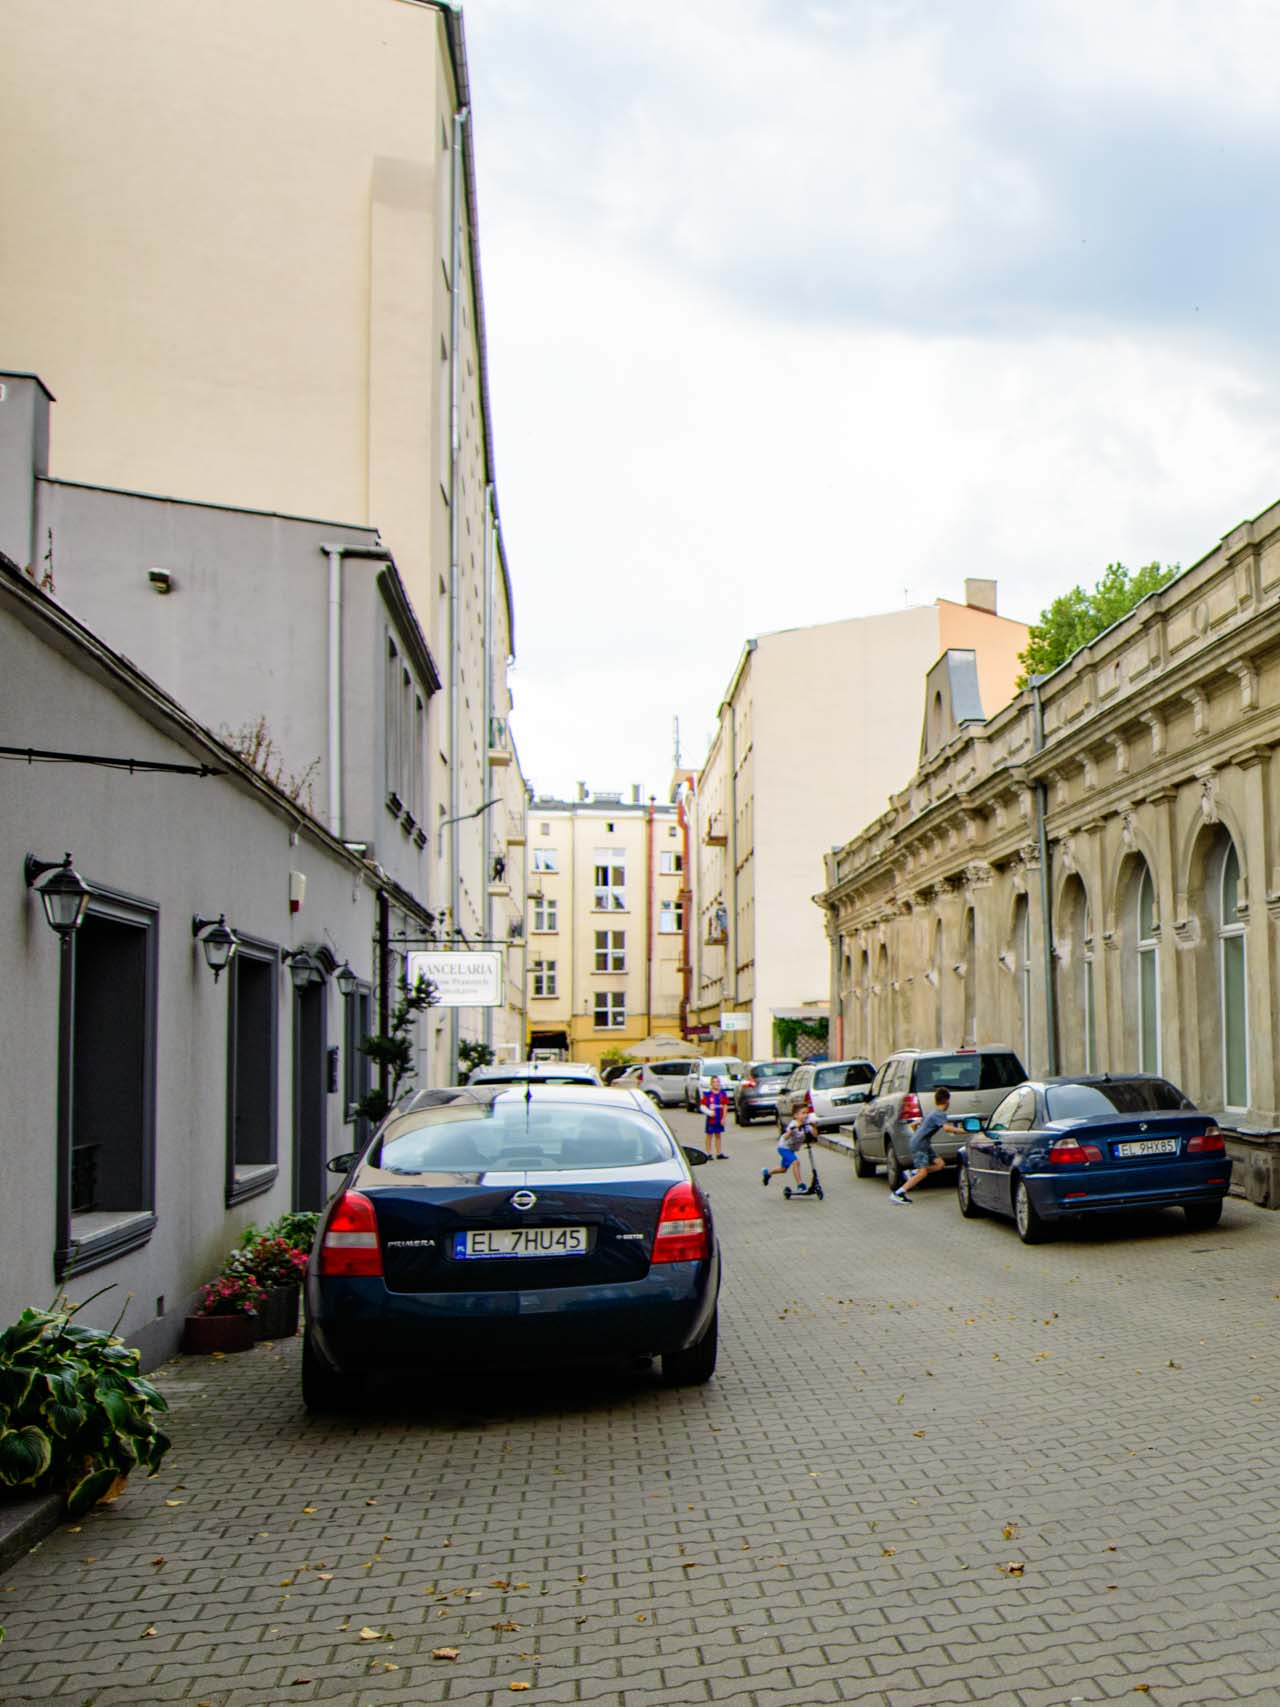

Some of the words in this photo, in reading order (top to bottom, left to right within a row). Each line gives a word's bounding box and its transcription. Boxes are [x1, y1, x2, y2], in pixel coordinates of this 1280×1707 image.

[1121, 1143, 1136, 1155] EL
[1139, 1140, 1174, 1153] 9HX85
[387, 1239, 436, 1248] PRIMERA
[472, 1232, 500, 1253] EL
[511, 1229, 581, 1251] 7HU45
